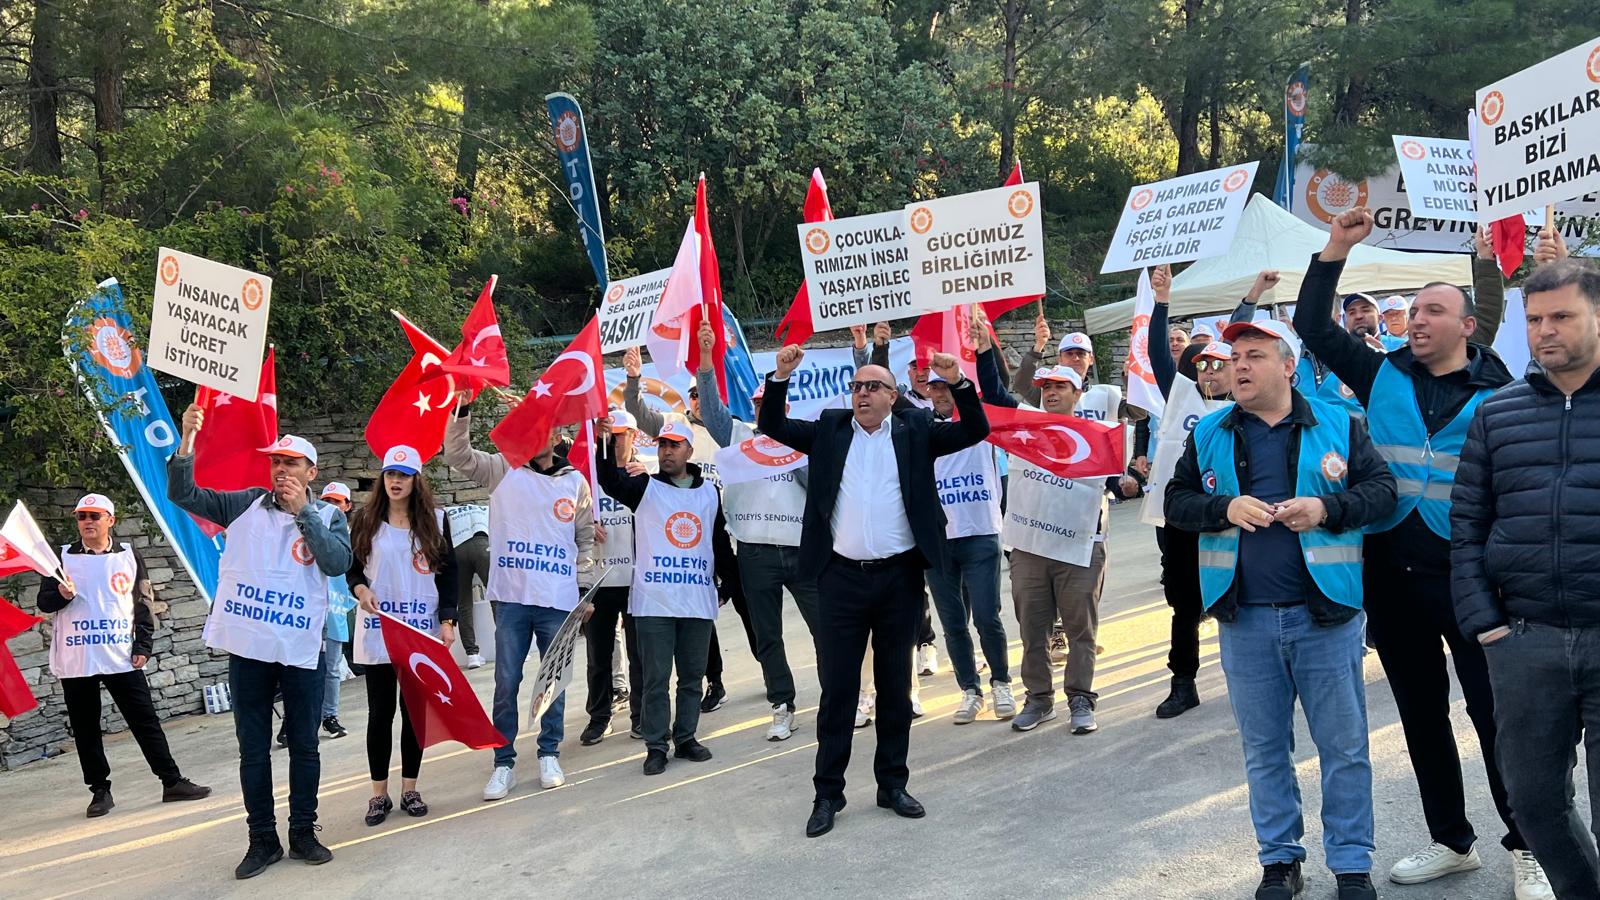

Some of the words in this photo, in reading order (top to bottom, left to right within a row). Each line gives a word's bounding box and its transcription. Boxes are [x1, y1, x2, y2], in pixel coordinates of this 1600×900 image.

[1494, 88, 1600, 146] BASKILAR
[1430, 146, 1463, 160] HAK
[1525, 127, 1566, 165] BİZİ
[1154, 179, 1221, 204] HAPIMAG
[1136, 209, 1162, 225] SEA
[1166, 197, 1228, 219] GARDEN
[927, 222, 1025, 252] GÜCÜMÜZ
[1172, 216, 1225, 237] YALNIZ
[815, 253, 868, 275] RIMIZIN
[942, 269, 1014, 295] DENDİR
[178, 278, 240, 314] İNSANCA
[607, 303, 625, 315] SEA
[819, 298, 864, 319] ÜCRET
[167, 301, 249, 339] YAŞAYACAK
[181, 325, 227, 355] ÜCRET
[164, 341, 239, 382] İSTİYORUZ
[507, 540, 567, 560] TOLEYİS
[498, 556, 572, 577] SENDİKASI
[653, 556, 708, 571] TOLEYİS
[236, 583, 305, 610] TOLEYİS
[72, 617, 128, 631] TOLEYİS
[224, 599, 311, 630] SENDİKASI
